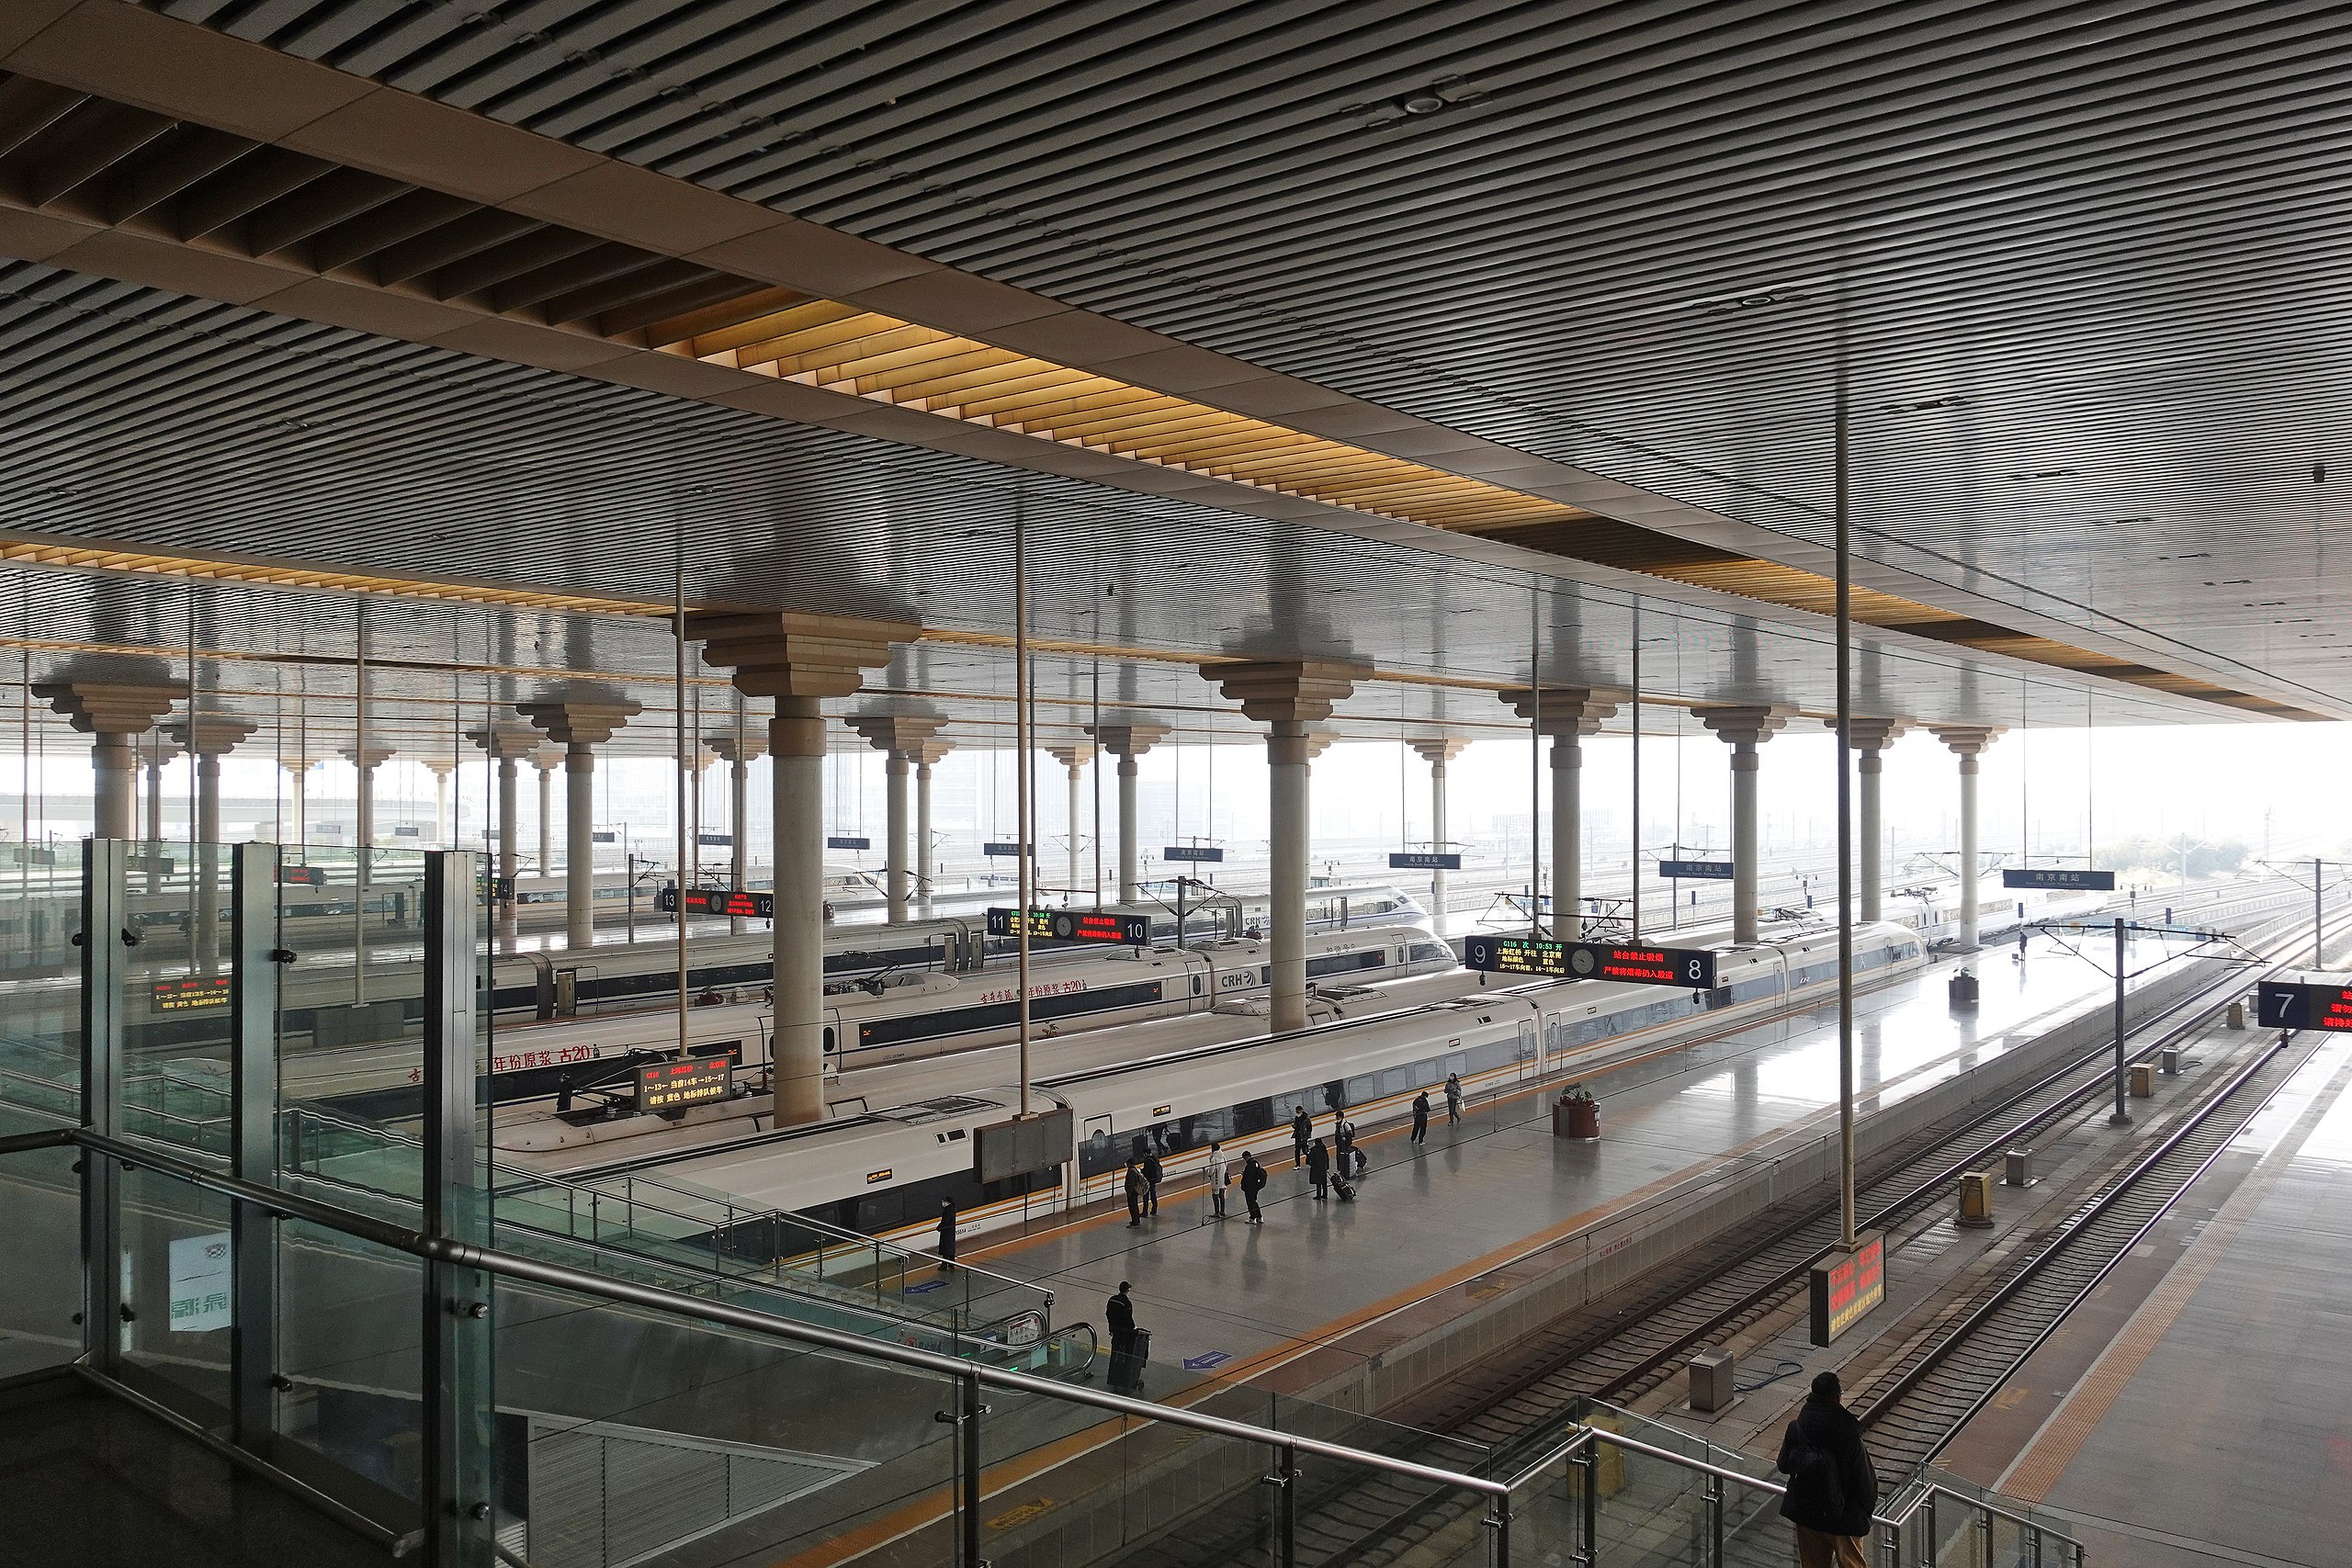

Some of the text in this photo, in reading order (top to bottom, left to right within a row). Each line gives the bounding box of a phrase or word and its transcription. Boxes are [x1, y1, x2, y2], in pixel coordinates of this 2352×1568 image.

[2035, 873, 2080, 882] 南京南站
[501, 884, 508, 894] 14
[664, 895, 675, 907] 13
[760, 899, 772, 912] 12
[991, 915, 1004, 930] 11
[1245, 917, 1261, 925] CRH
[1127, 923, 1143, 939] 10
[1474, 944, 1487, 964] 9
[1496, 947, 1522, 956] 上海虹桥
[1542, 951, 1563, 959] 北京南
[1612, 950, 1664, 963] 站台禁止吸烟
[1603, 965, 1674, 980] 严禁将烟蒂扔入股道
[1688, 959, 1702, 980] 8
[1063, 980, 1081, 993] 古20
[1221, 974, 1242, 987] CRH
[2275, 993, 2295, 1019] 7
[493, 1051, 552, 1072] 年份原浆
[558, 1044, 590, 1062] 古20
[646, 1071, 660, 1079] G116
[650, 1085, 724, 1105] 请按 蓝色 地标排队候车
